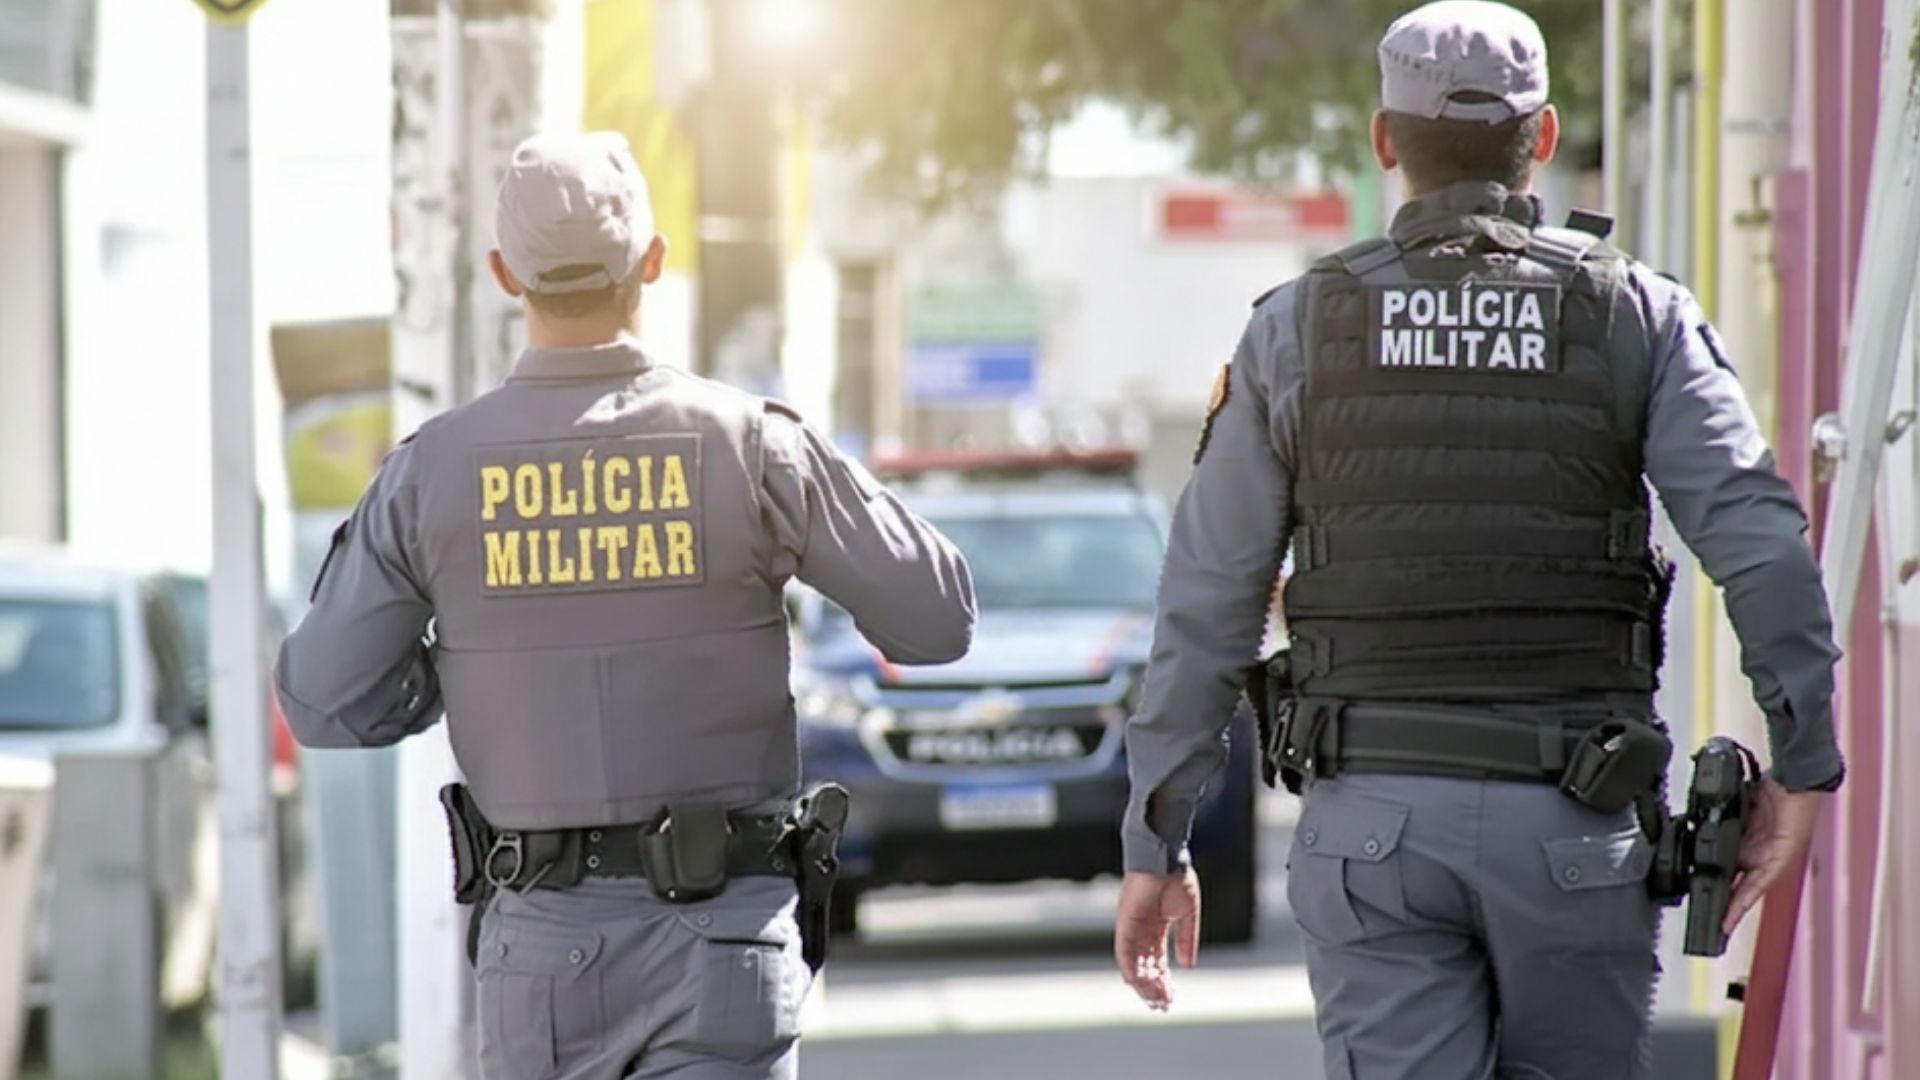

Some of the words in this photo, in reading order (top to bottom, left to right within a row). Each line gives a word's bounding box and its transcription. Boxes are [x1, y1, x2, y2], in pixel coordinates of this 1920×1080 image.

[1382, 281, 1544, 329] POLÍCIA
[1380, 329, 1546, 370] MILITAR
[481, 448, 691, 520] POLÍCIA
[484, 521, 695, 587] MILITAR
